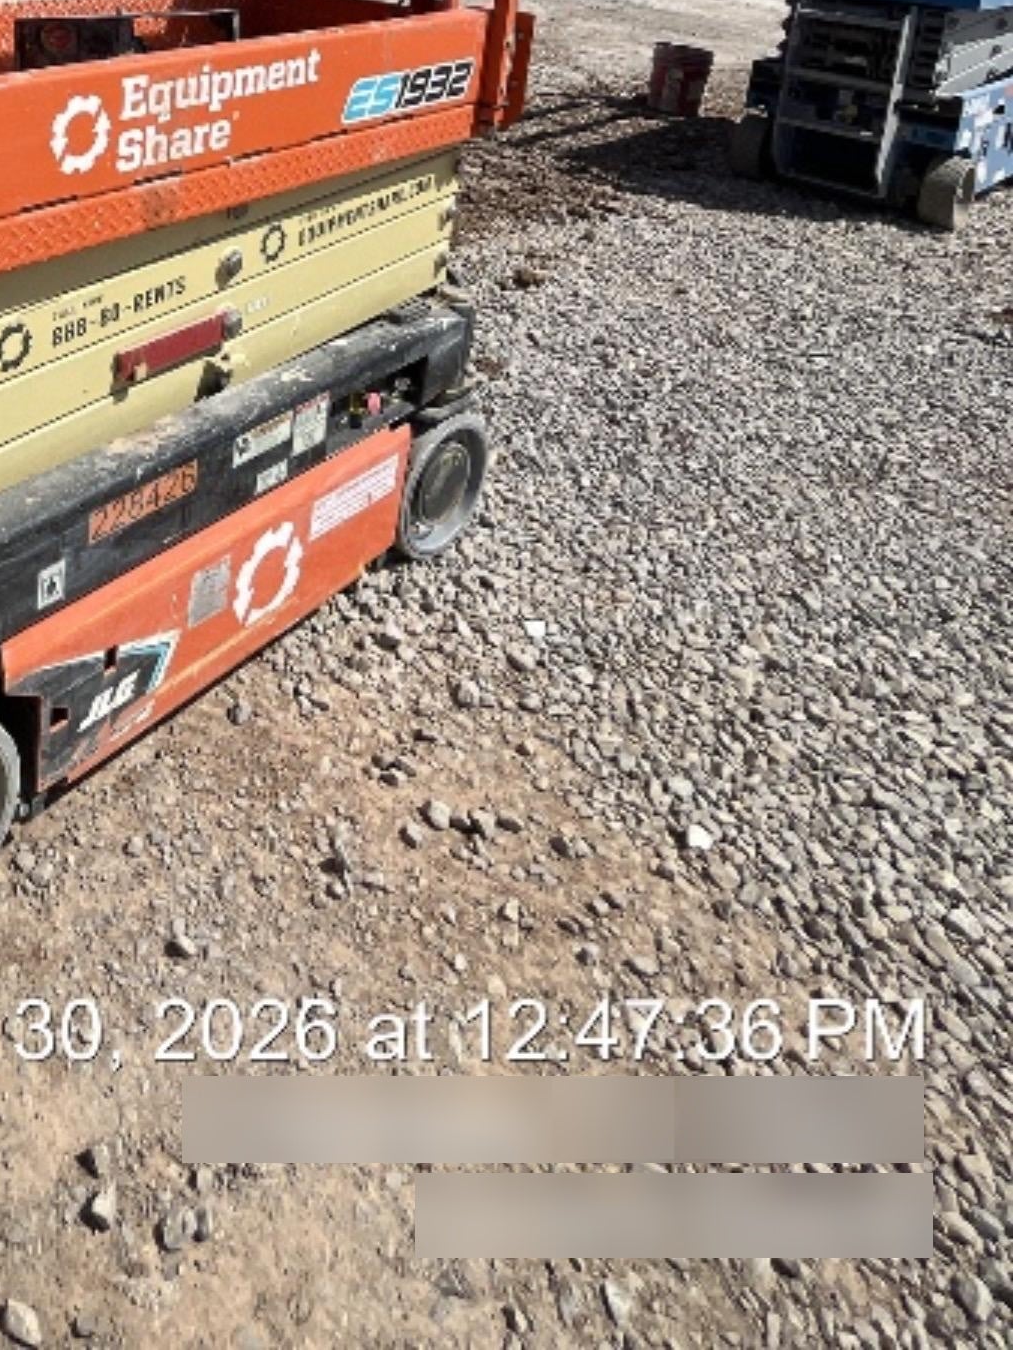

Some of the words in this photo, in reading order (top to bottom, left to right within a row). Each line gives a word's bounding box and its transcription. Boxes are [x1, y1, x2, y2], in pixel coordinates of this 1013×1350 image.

[119, 48, 321, 123] Equipment
[342, 57, 475, 122] ES1932
[115, 118, 231, 173] Share
[76, 667, 141, 733] JLG
